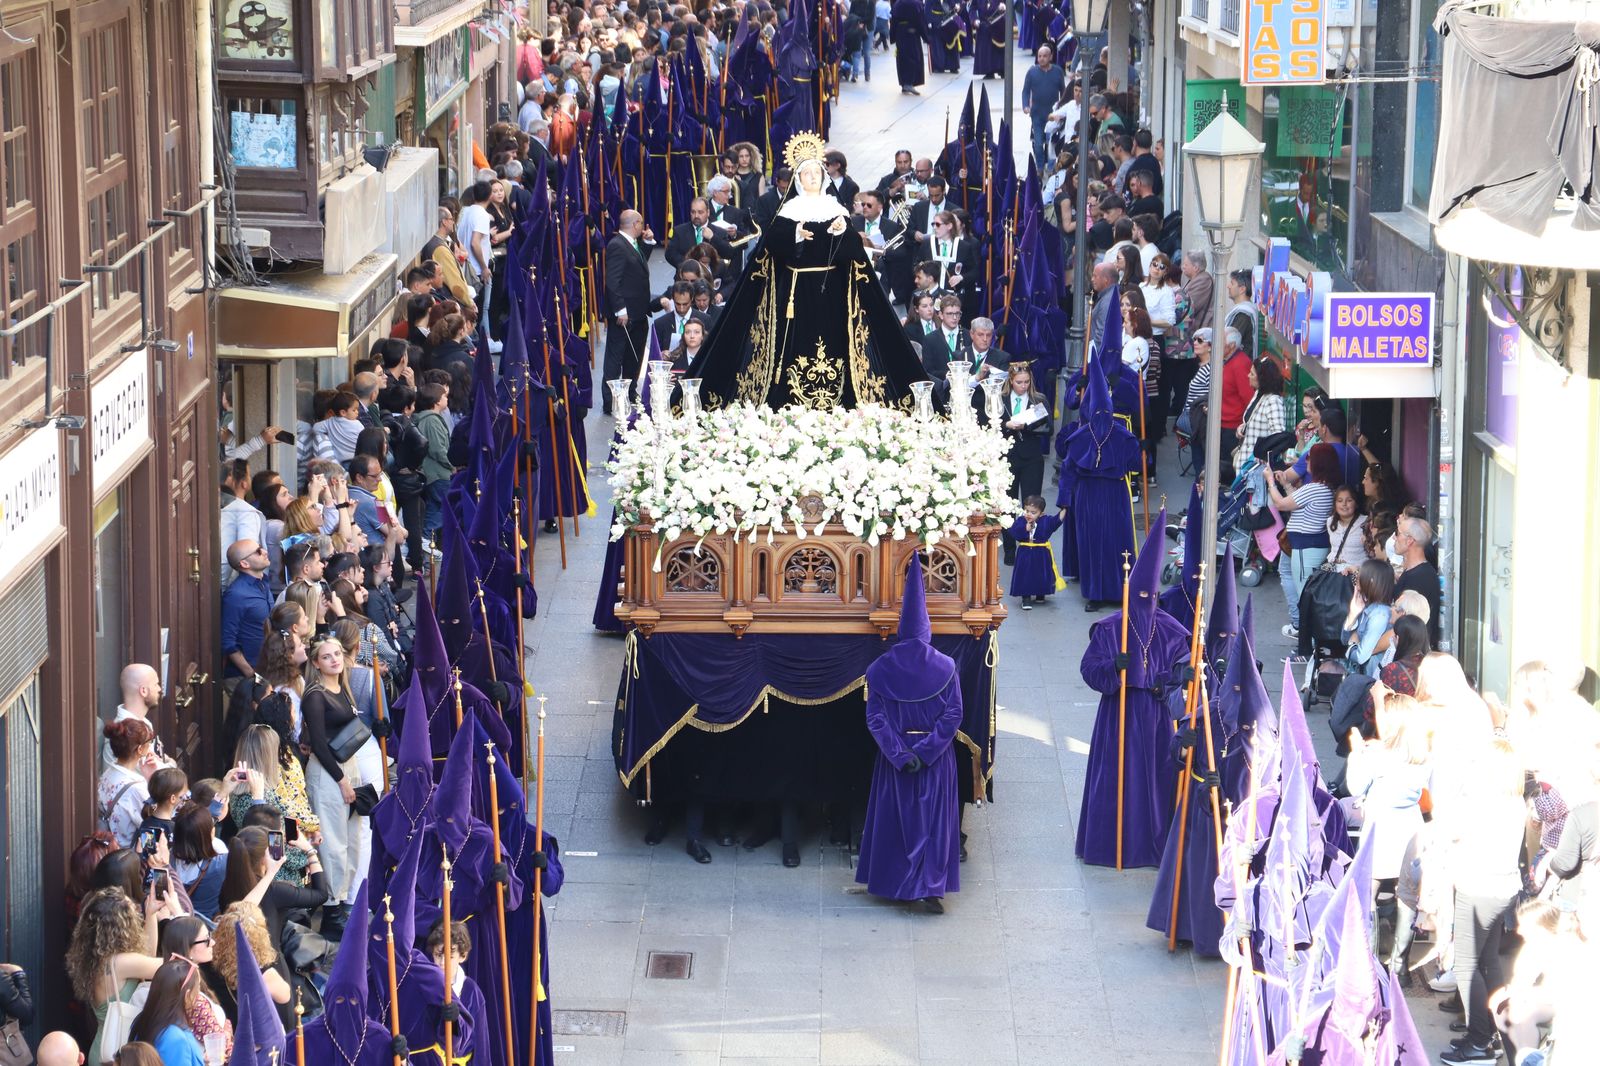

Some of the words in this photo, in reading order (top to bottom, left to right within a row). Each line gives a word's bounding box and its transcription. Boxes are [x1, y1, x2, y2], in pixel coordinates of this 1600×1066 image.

[1337, 304, 1423, 327] BOLSOS
[1331, 335, 1428, 358] MALETAS
[5, 476, 30, 536] PLAZA
[31, 453, 57, 513] MAYOR
